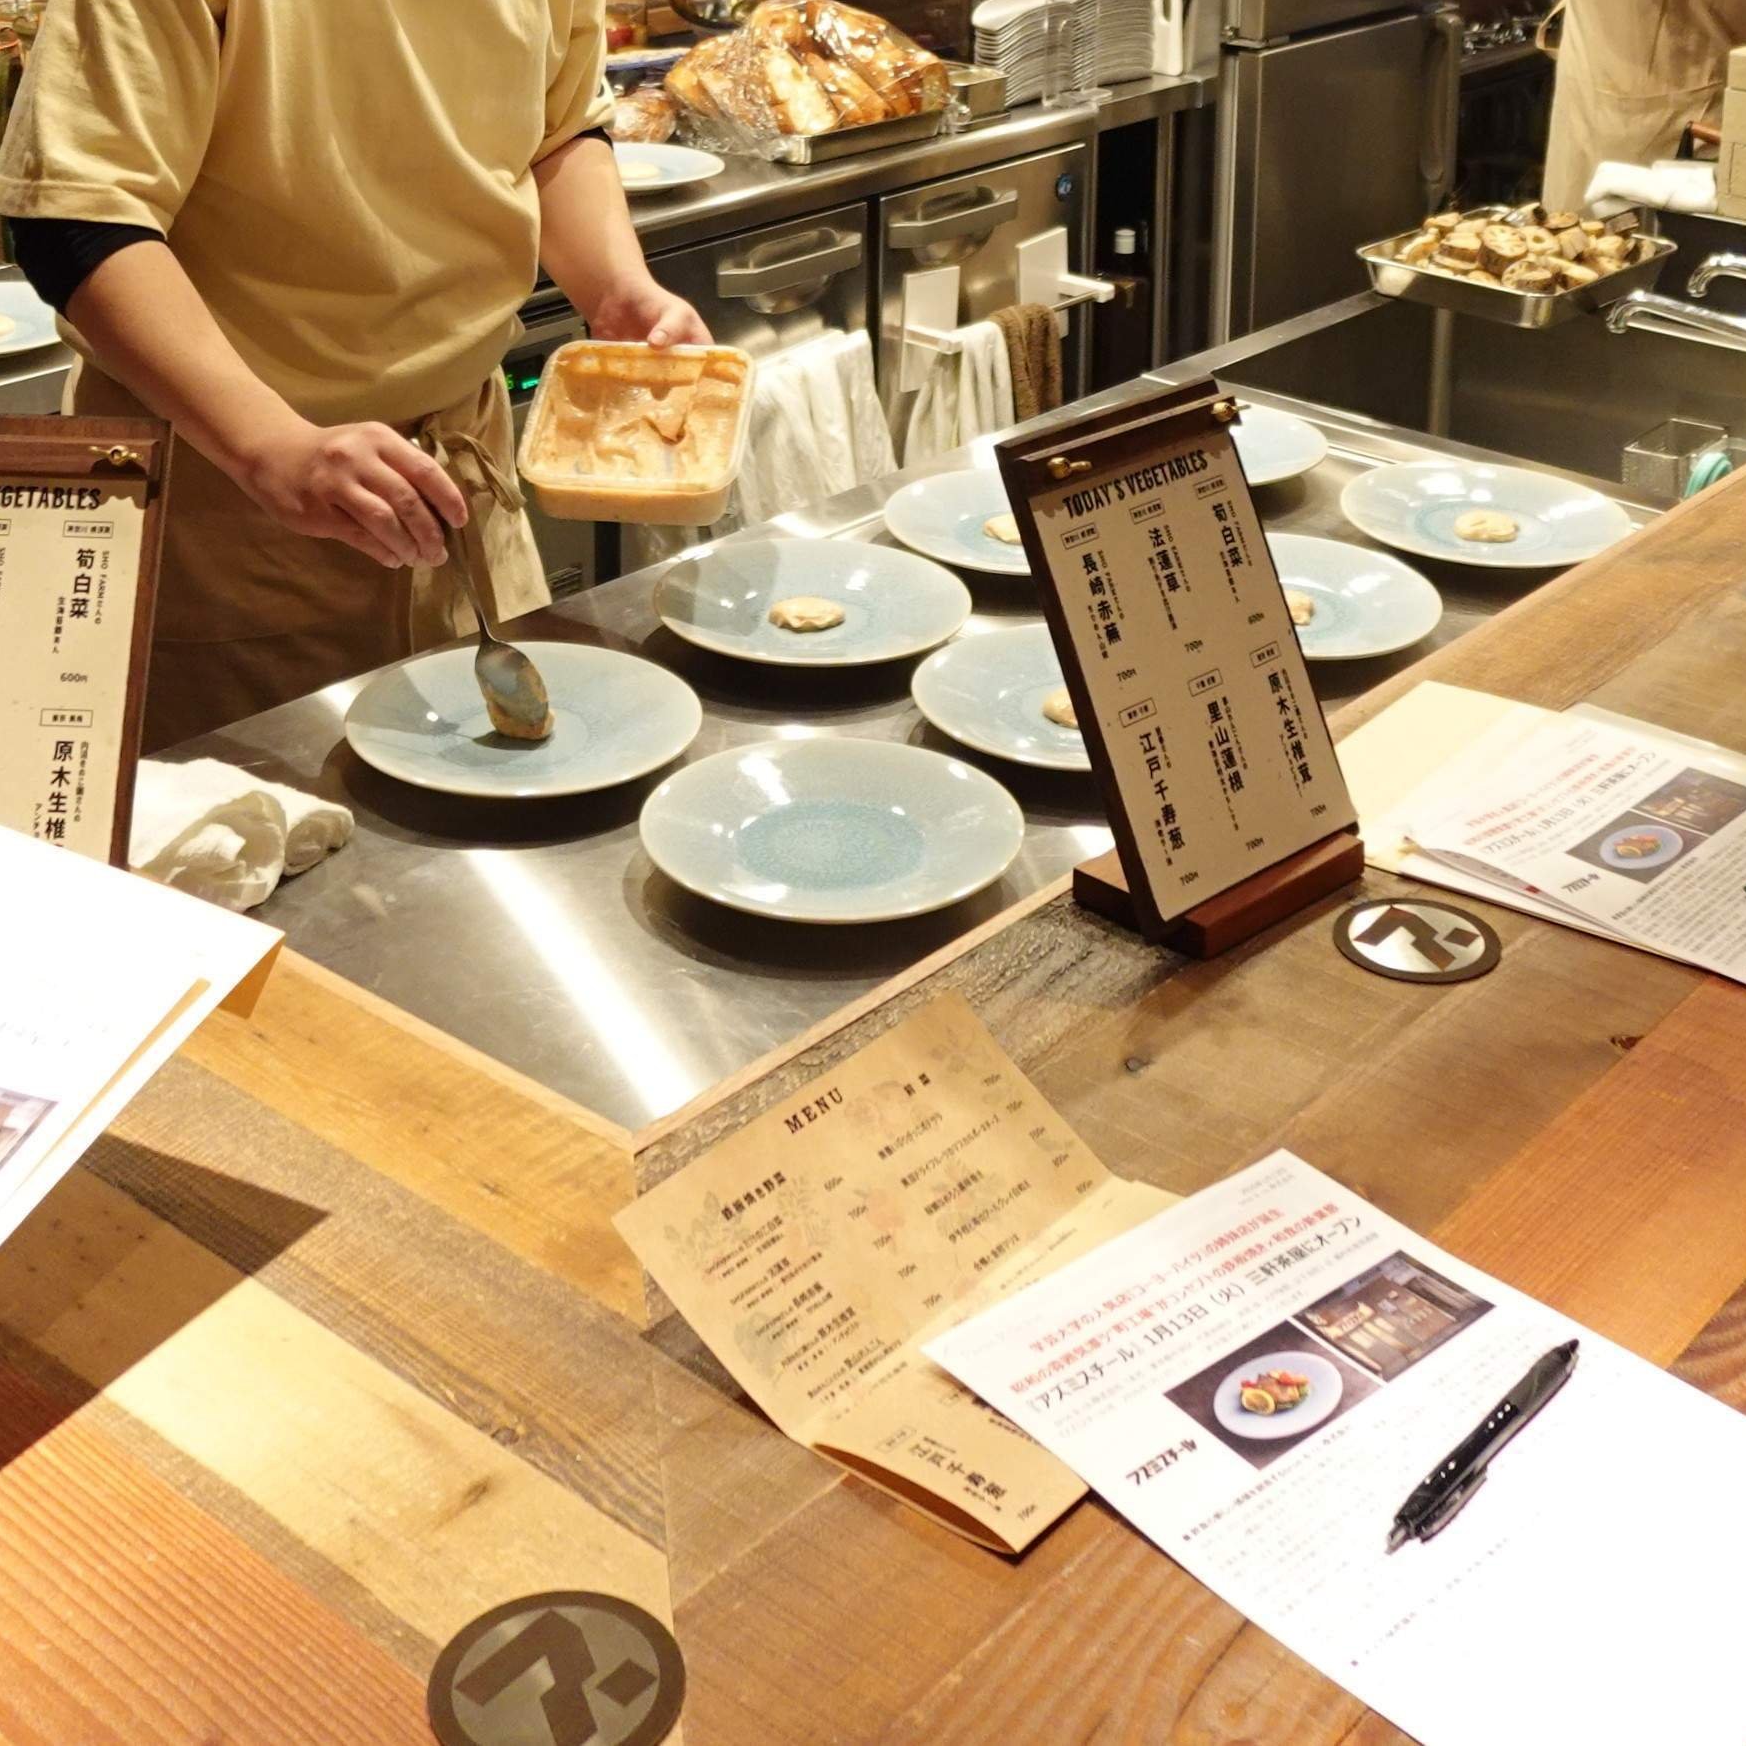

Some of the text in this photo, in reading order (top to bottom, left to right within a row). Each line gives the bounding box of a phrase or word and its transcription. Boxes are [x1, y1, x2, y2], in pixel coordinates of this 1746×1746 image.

[1061, 448, 1210, 520] TODAY'S VEGETABLES
[1147, 526, 1181, 594] 法蓮草
[1211, 502, 1244, 568] 筍白菜
[69, 548, 96, 619] 筍白菜
[1079, 551, 1122, 646] 長崎赤蕪
[1203, 699, 1246, 794] 里山蓮根
[1264, 671, 1315, 785] 原木生椎茸
[1138, 733, 1187, 852] 江戸千寿葱
[781, 1086, 848, 1134] MENU
[718, 1170, 789, 1221] 鉄板焼き野菜
